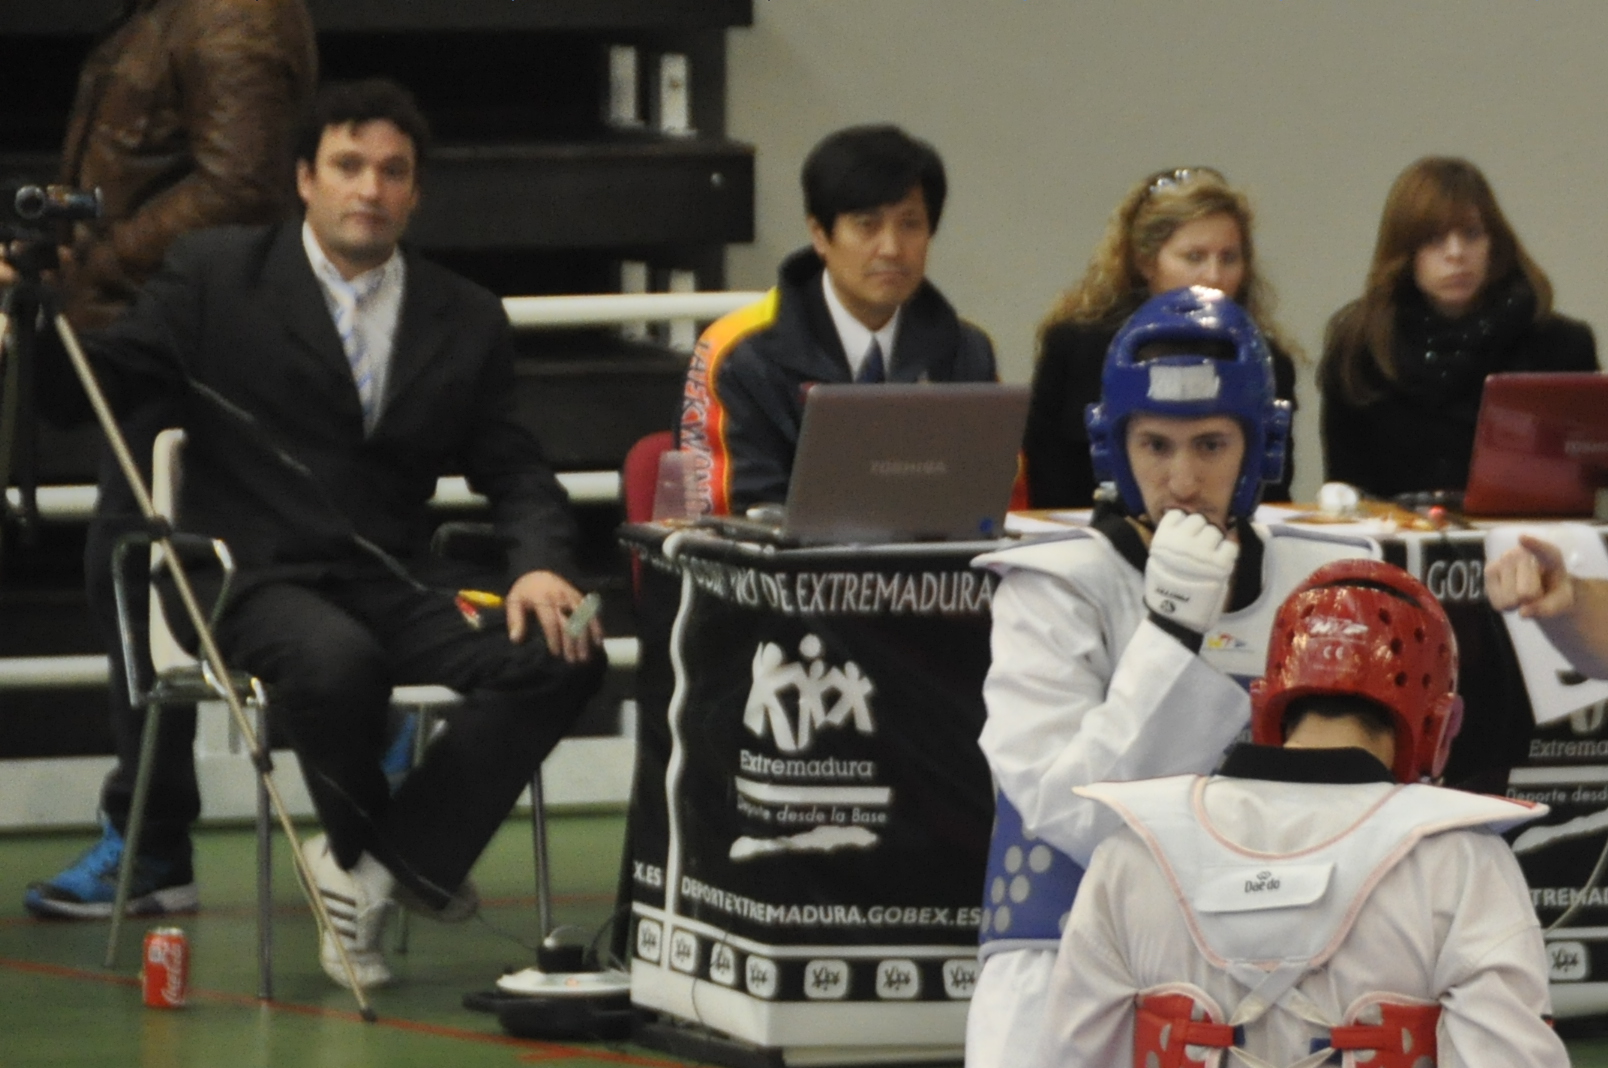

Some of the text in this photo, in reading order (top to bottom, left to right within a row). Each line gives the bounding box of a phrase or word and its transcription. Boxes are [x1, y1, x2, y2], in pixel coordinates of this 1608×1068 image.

[760, 571, 794, 612] DE
[796, 572, 994, 614] EXTREMADURA
[740, 750, 873, 777] Extremadura
[776, 804, 825, 822] desde
[831, 806, 846, 822] la
[851, 808, 887, 823] Base
